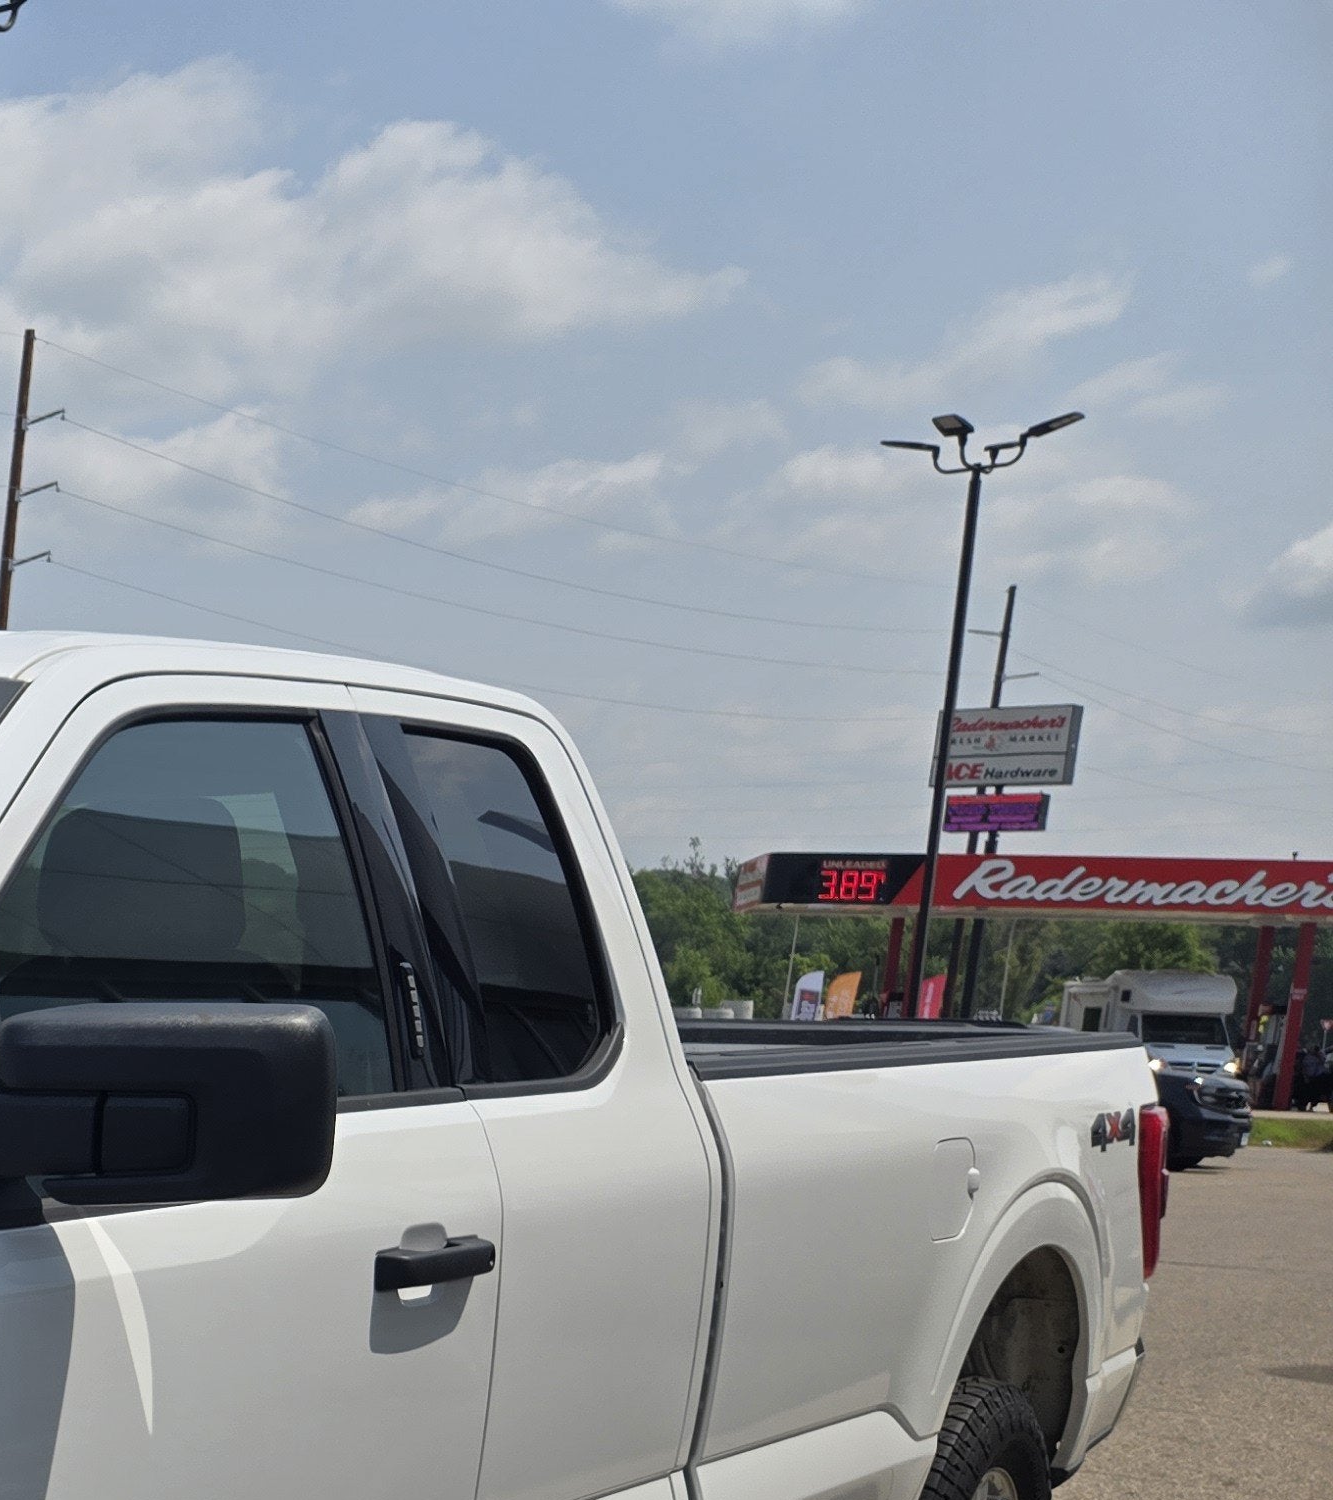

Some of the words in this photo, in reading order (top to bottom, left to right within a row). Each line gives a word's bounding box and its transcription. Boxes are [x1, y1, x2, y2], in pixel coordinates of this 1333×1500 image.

[950, 737, 981, 745] RESH
[1009, 734, 1060, 743] MARKET
[984, 767, 1058, 780] Hardware
